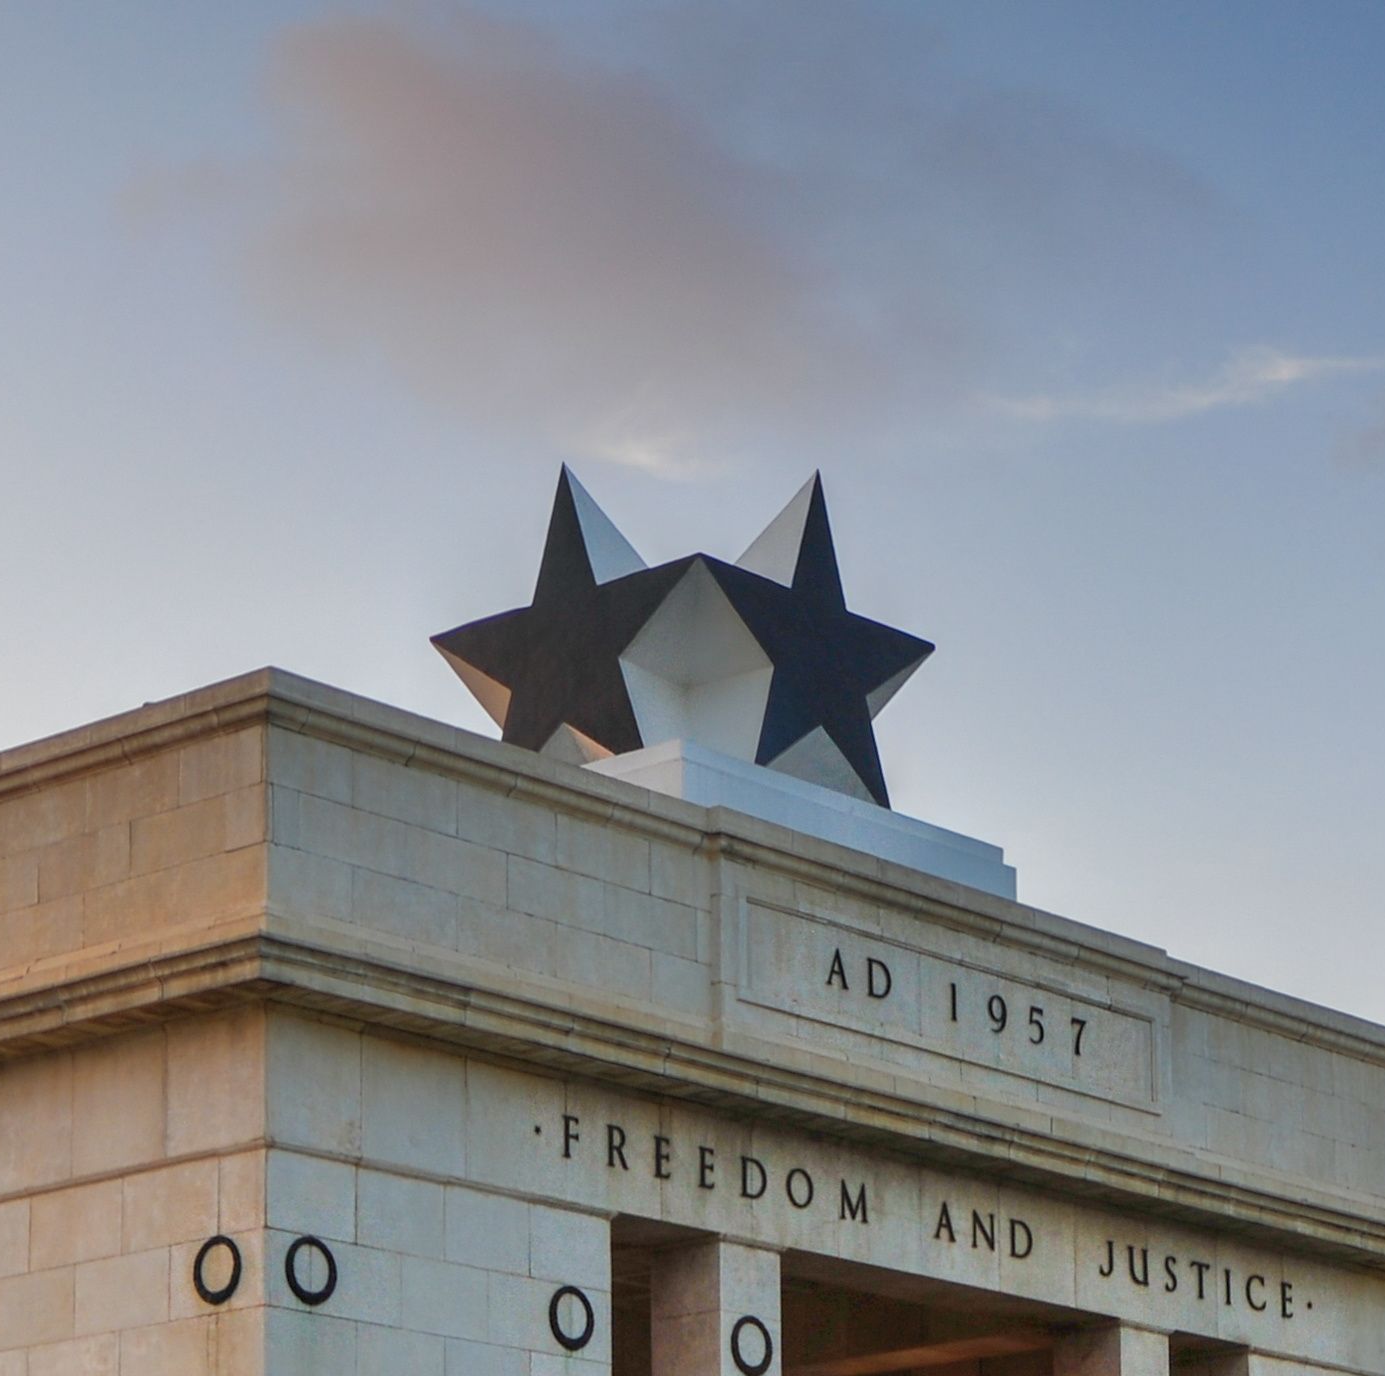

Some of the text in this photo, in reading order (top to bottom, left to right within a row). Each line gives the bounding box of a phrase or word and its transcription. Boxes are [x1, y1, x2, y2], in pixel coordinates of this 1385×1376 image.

[825, 947, 1087, 1056] AD 1957
[933, 1201, 1033, 1259] AND
